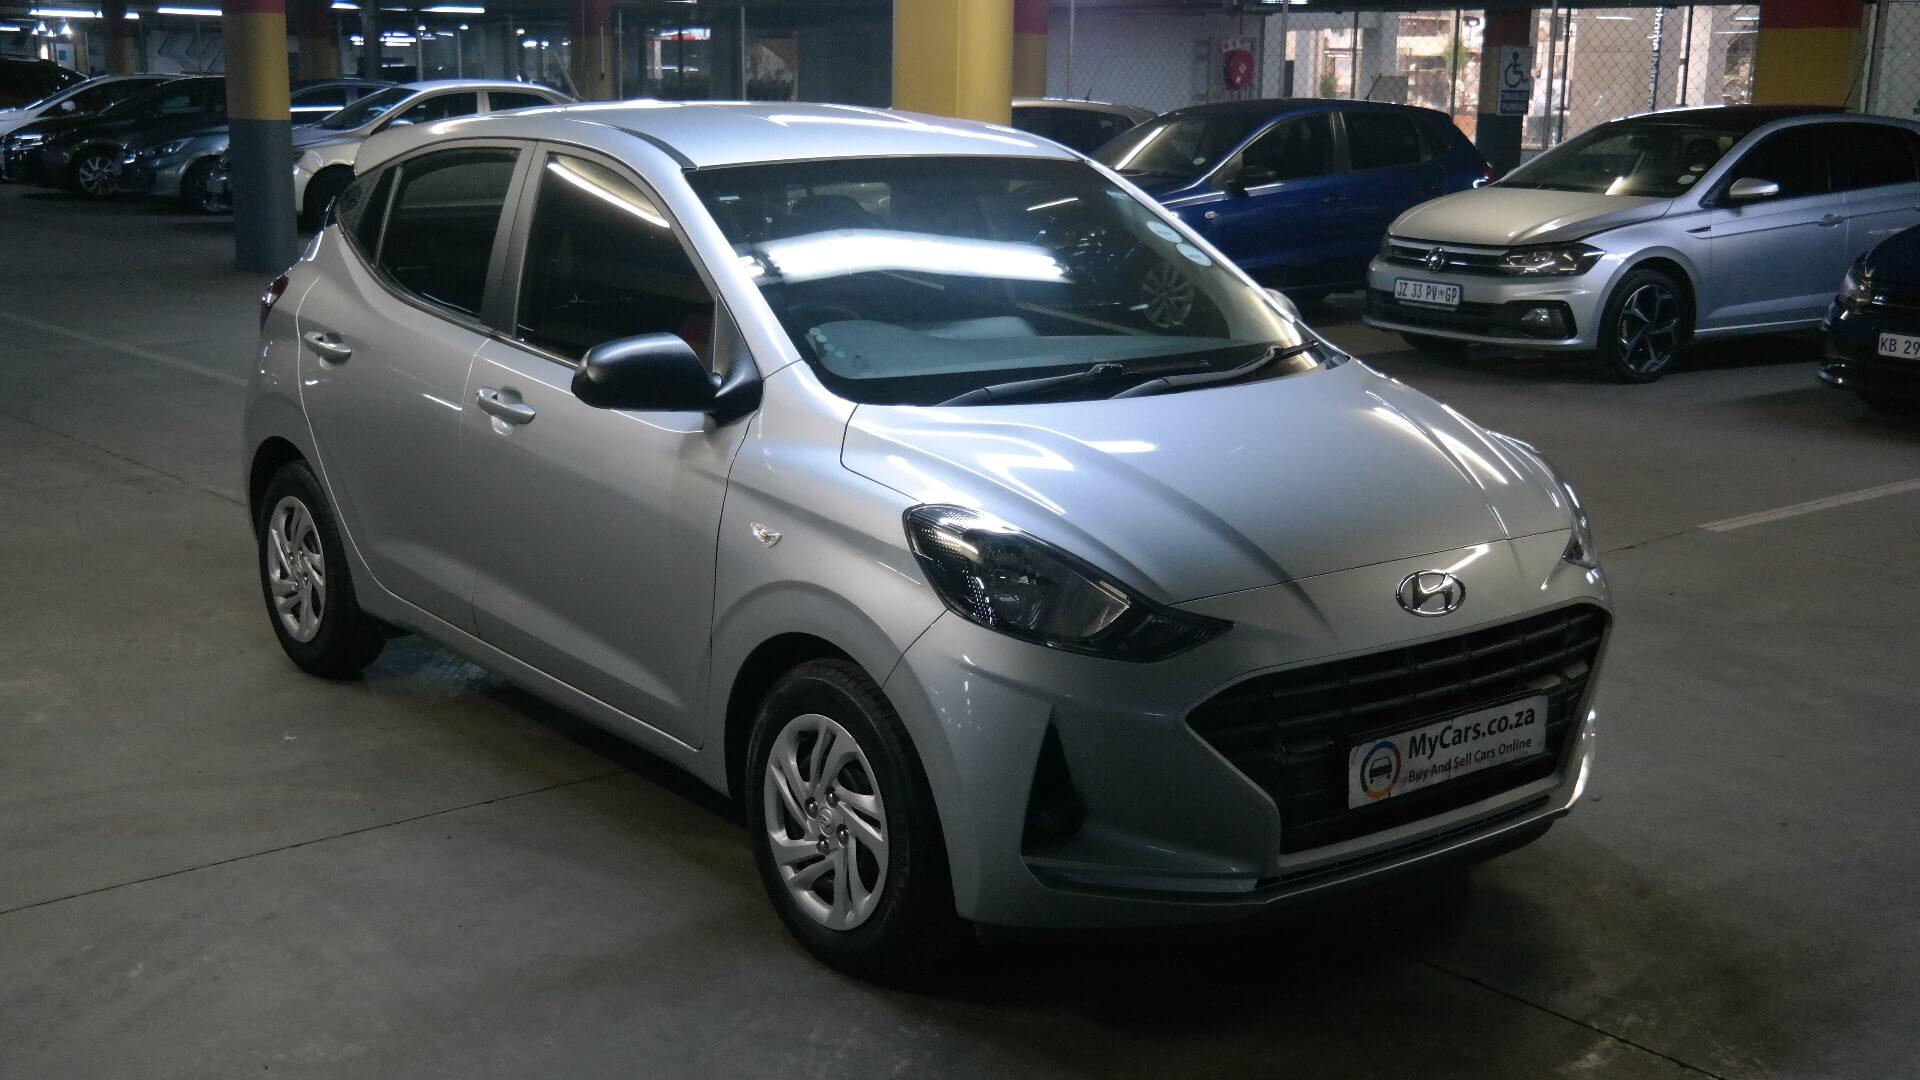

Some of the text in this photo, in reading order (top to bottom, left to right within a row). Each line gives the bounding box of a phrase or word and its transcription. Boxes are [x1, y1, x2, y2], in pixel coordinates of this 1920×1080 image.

[1411, 283, 1423, 298] 33
[1425, 285, 1439, 301] PV
[1445, 287, 1458, 302] GP
[1880, 336, 1920, 355] KB 29
[1408, 708, 1536, 760] MyCars.co.za
[1408, 737, 1532, 783] Buy And Sell Cars Online
